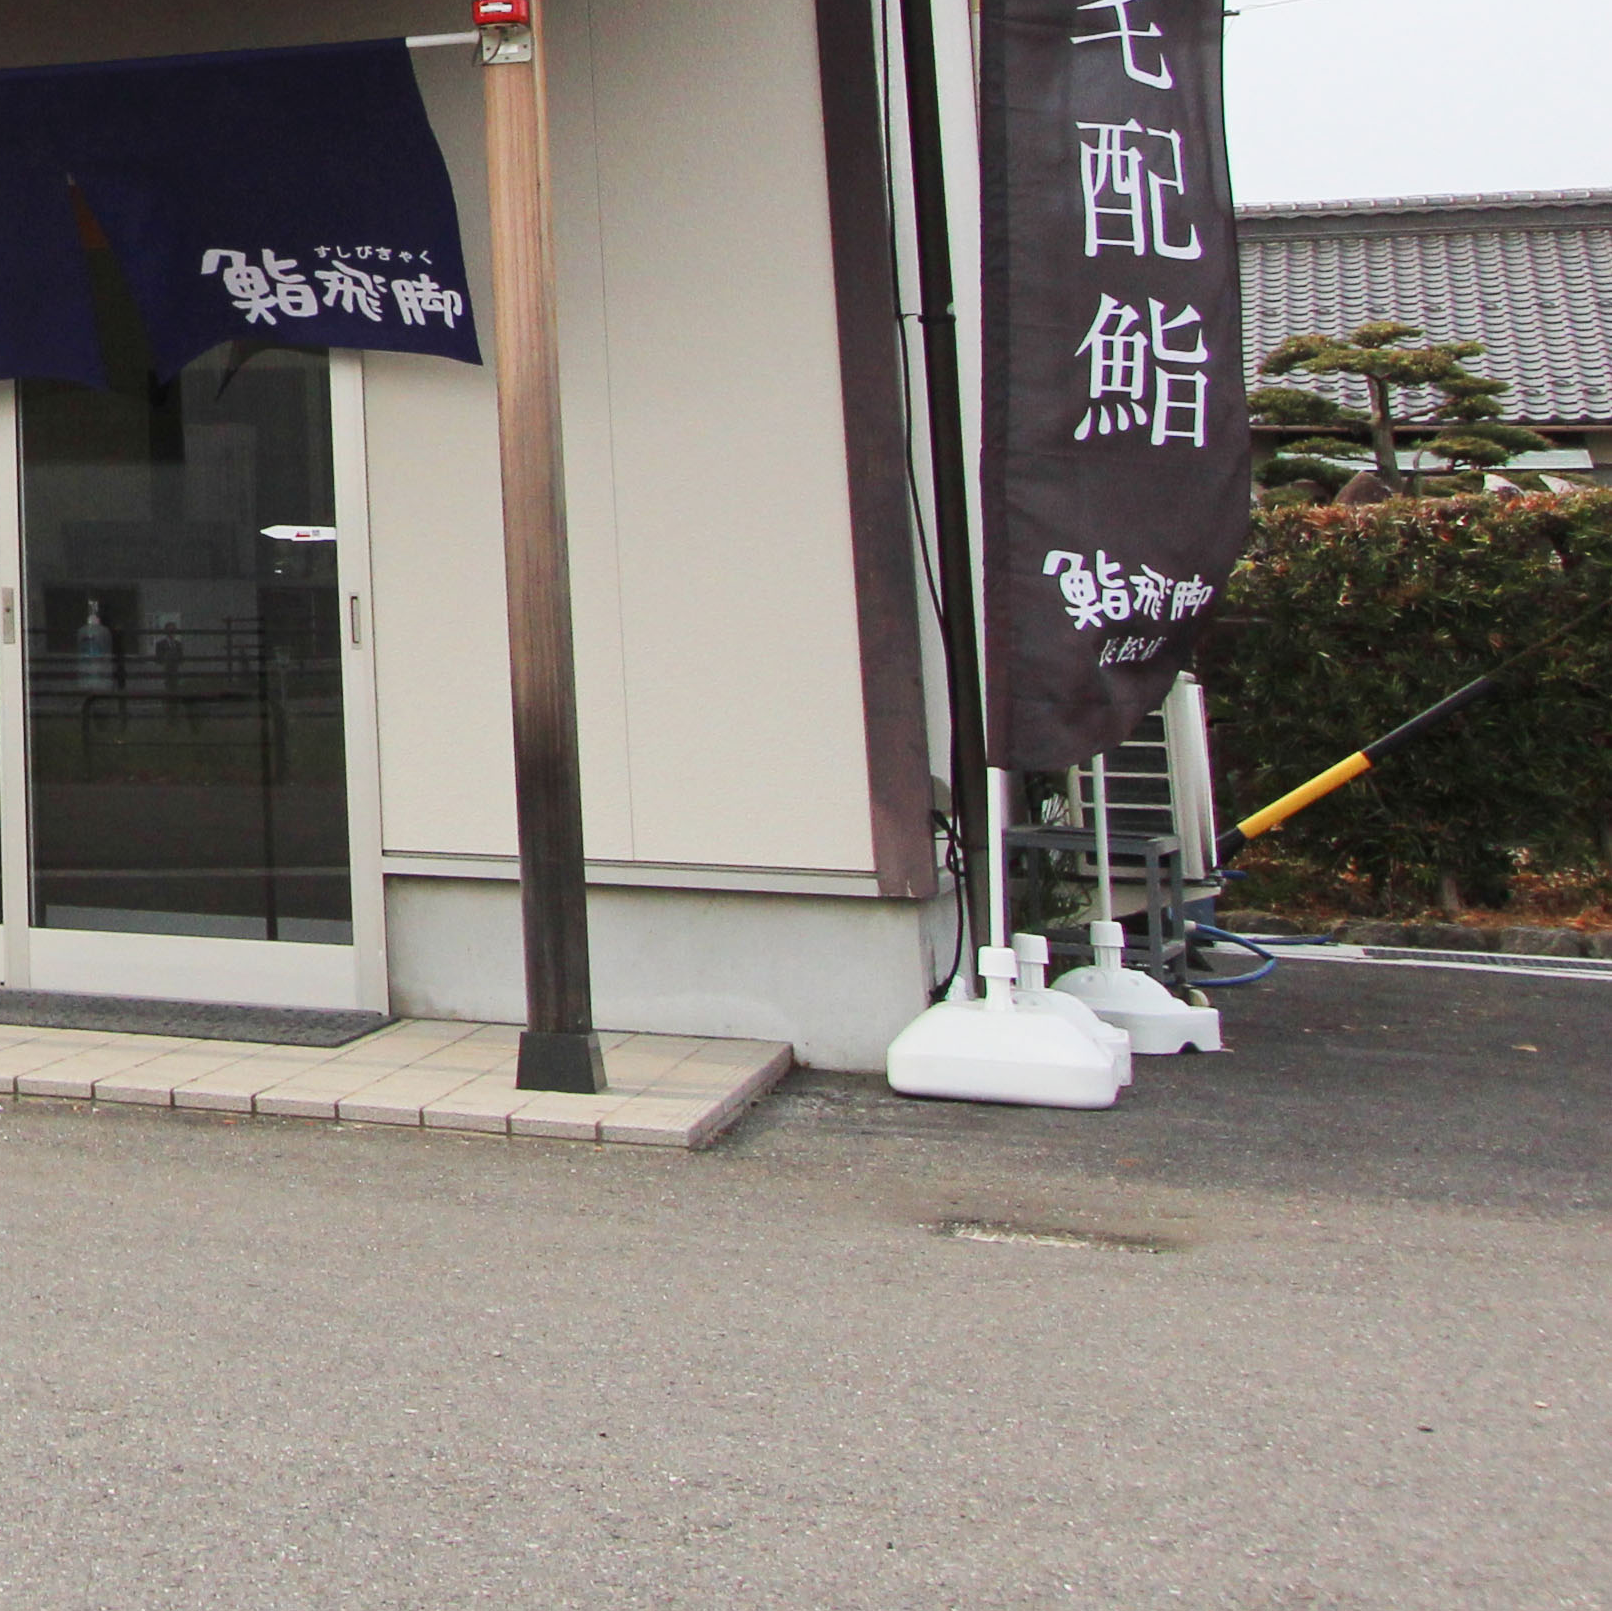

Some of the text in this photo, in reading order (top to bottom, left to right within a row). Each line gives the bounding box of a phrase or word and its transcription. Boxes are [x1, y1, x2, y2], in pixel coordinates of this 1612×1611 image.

[201, 248, 463, 329] 鮨飛脚
[314, 245, 432, 264] すしびきゃく
[1042, 549, 1214, 630] 鮨飛脚
